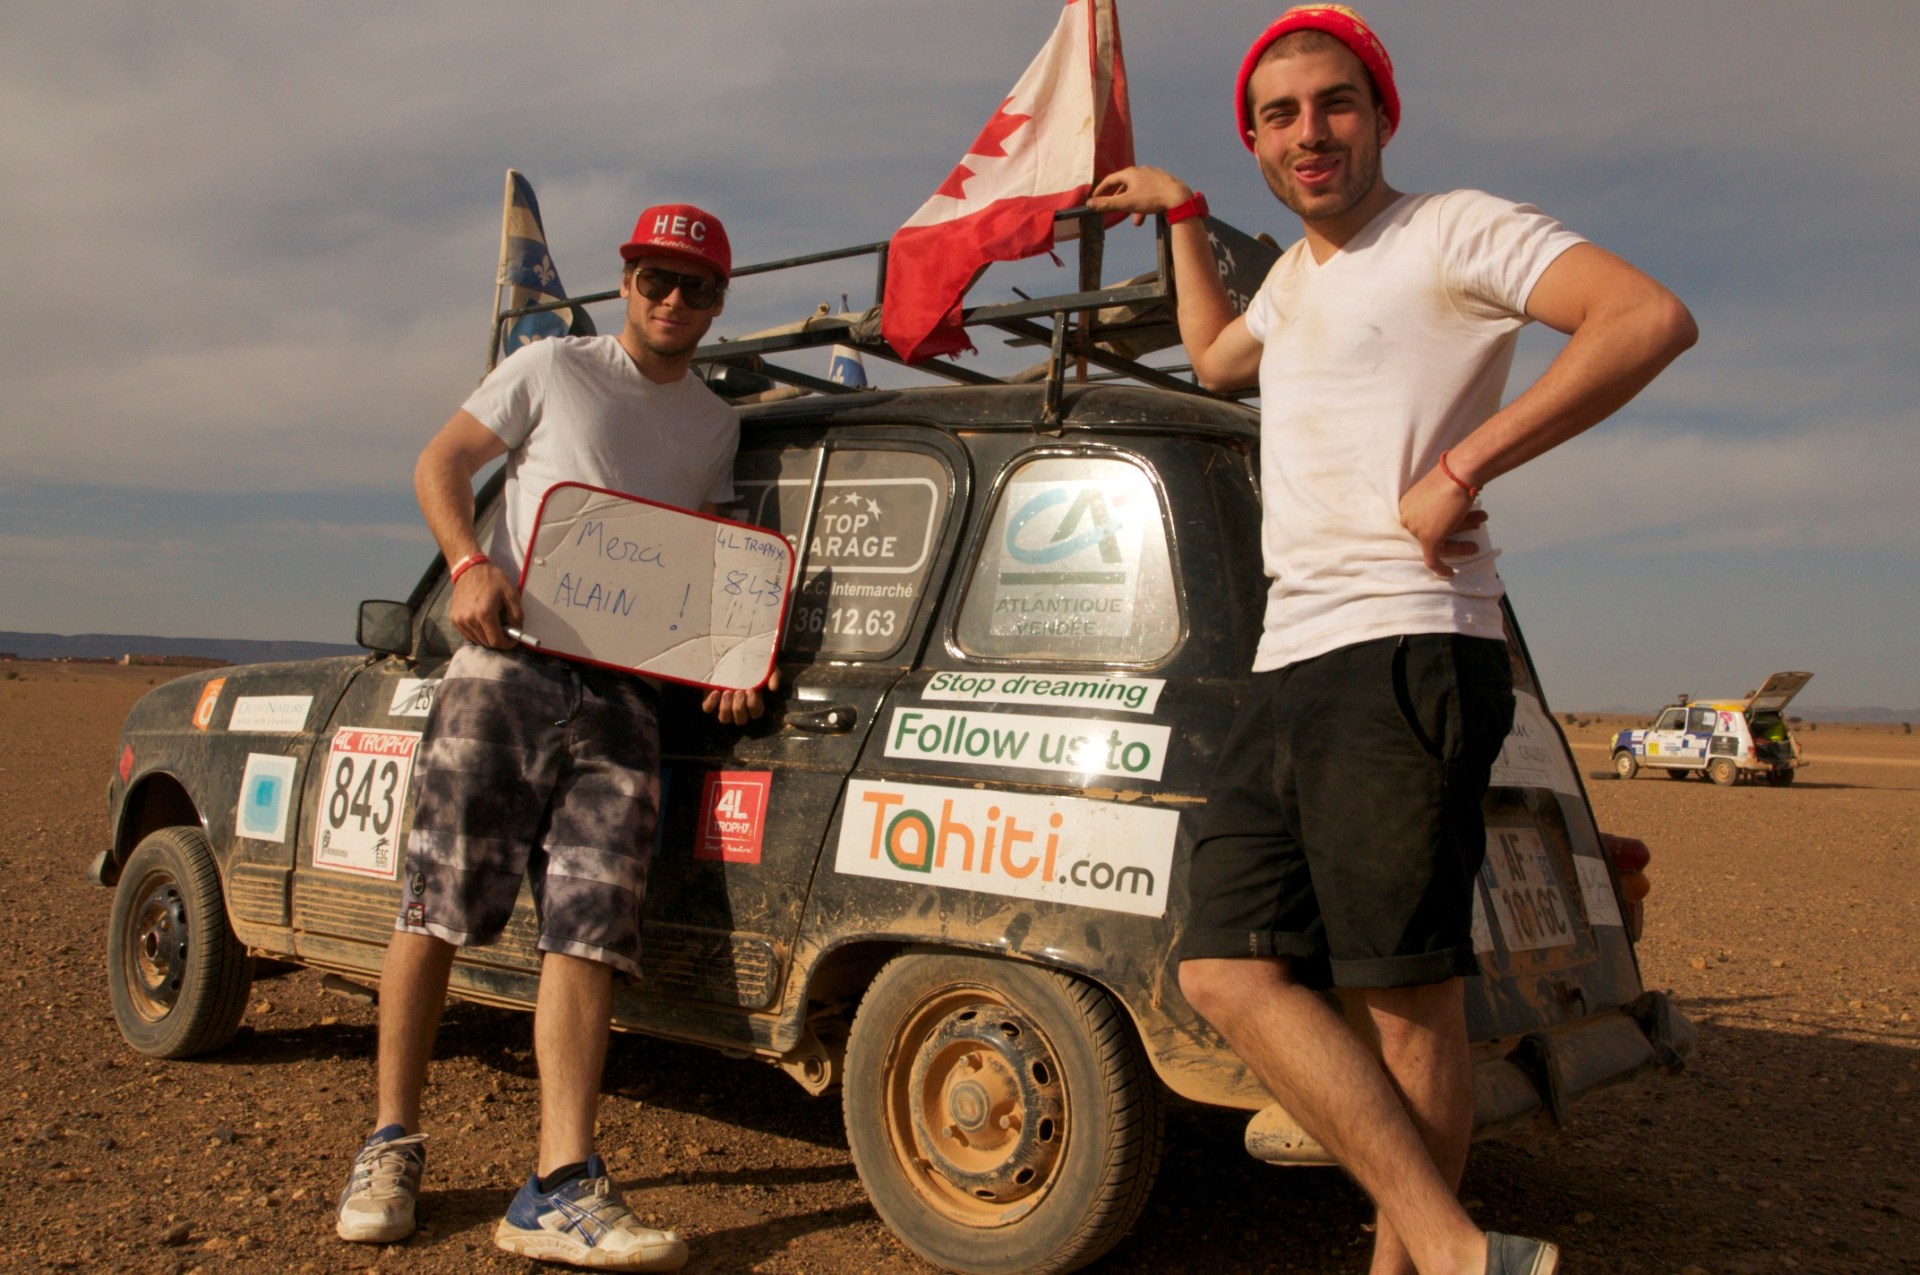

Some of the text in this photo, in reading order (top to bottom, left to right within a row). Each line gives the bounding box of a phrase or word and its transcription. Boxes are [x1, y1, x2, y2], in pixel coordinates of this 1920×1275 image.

[653, 214, 706, 241] HEC
[824, 514, 869, 534] TOP
[576, 520, 665, 568] Merci
[744, 537, 785, 560] TROPHY
[553, 572, 636, 616] ALAIN
[724, 570, 781, 606] 843
[831, 581, 913, 598] Intermarché
[996, 598, 1122, 613] ATLANTIQUE
[930, 673, 1149, 709] Stop dreaming
[336, 731, 417, 757] 4L TROPHY
[894, 713, 1029, 760] Follow
[1107, 729, 1150, 773] to
[329, 756, 398, 835] 843
[717, 789, 748, 819] 4L
[714, 821, 750, 834] TROPHY
[862, 791, 1154, 896] Tahiti.com
